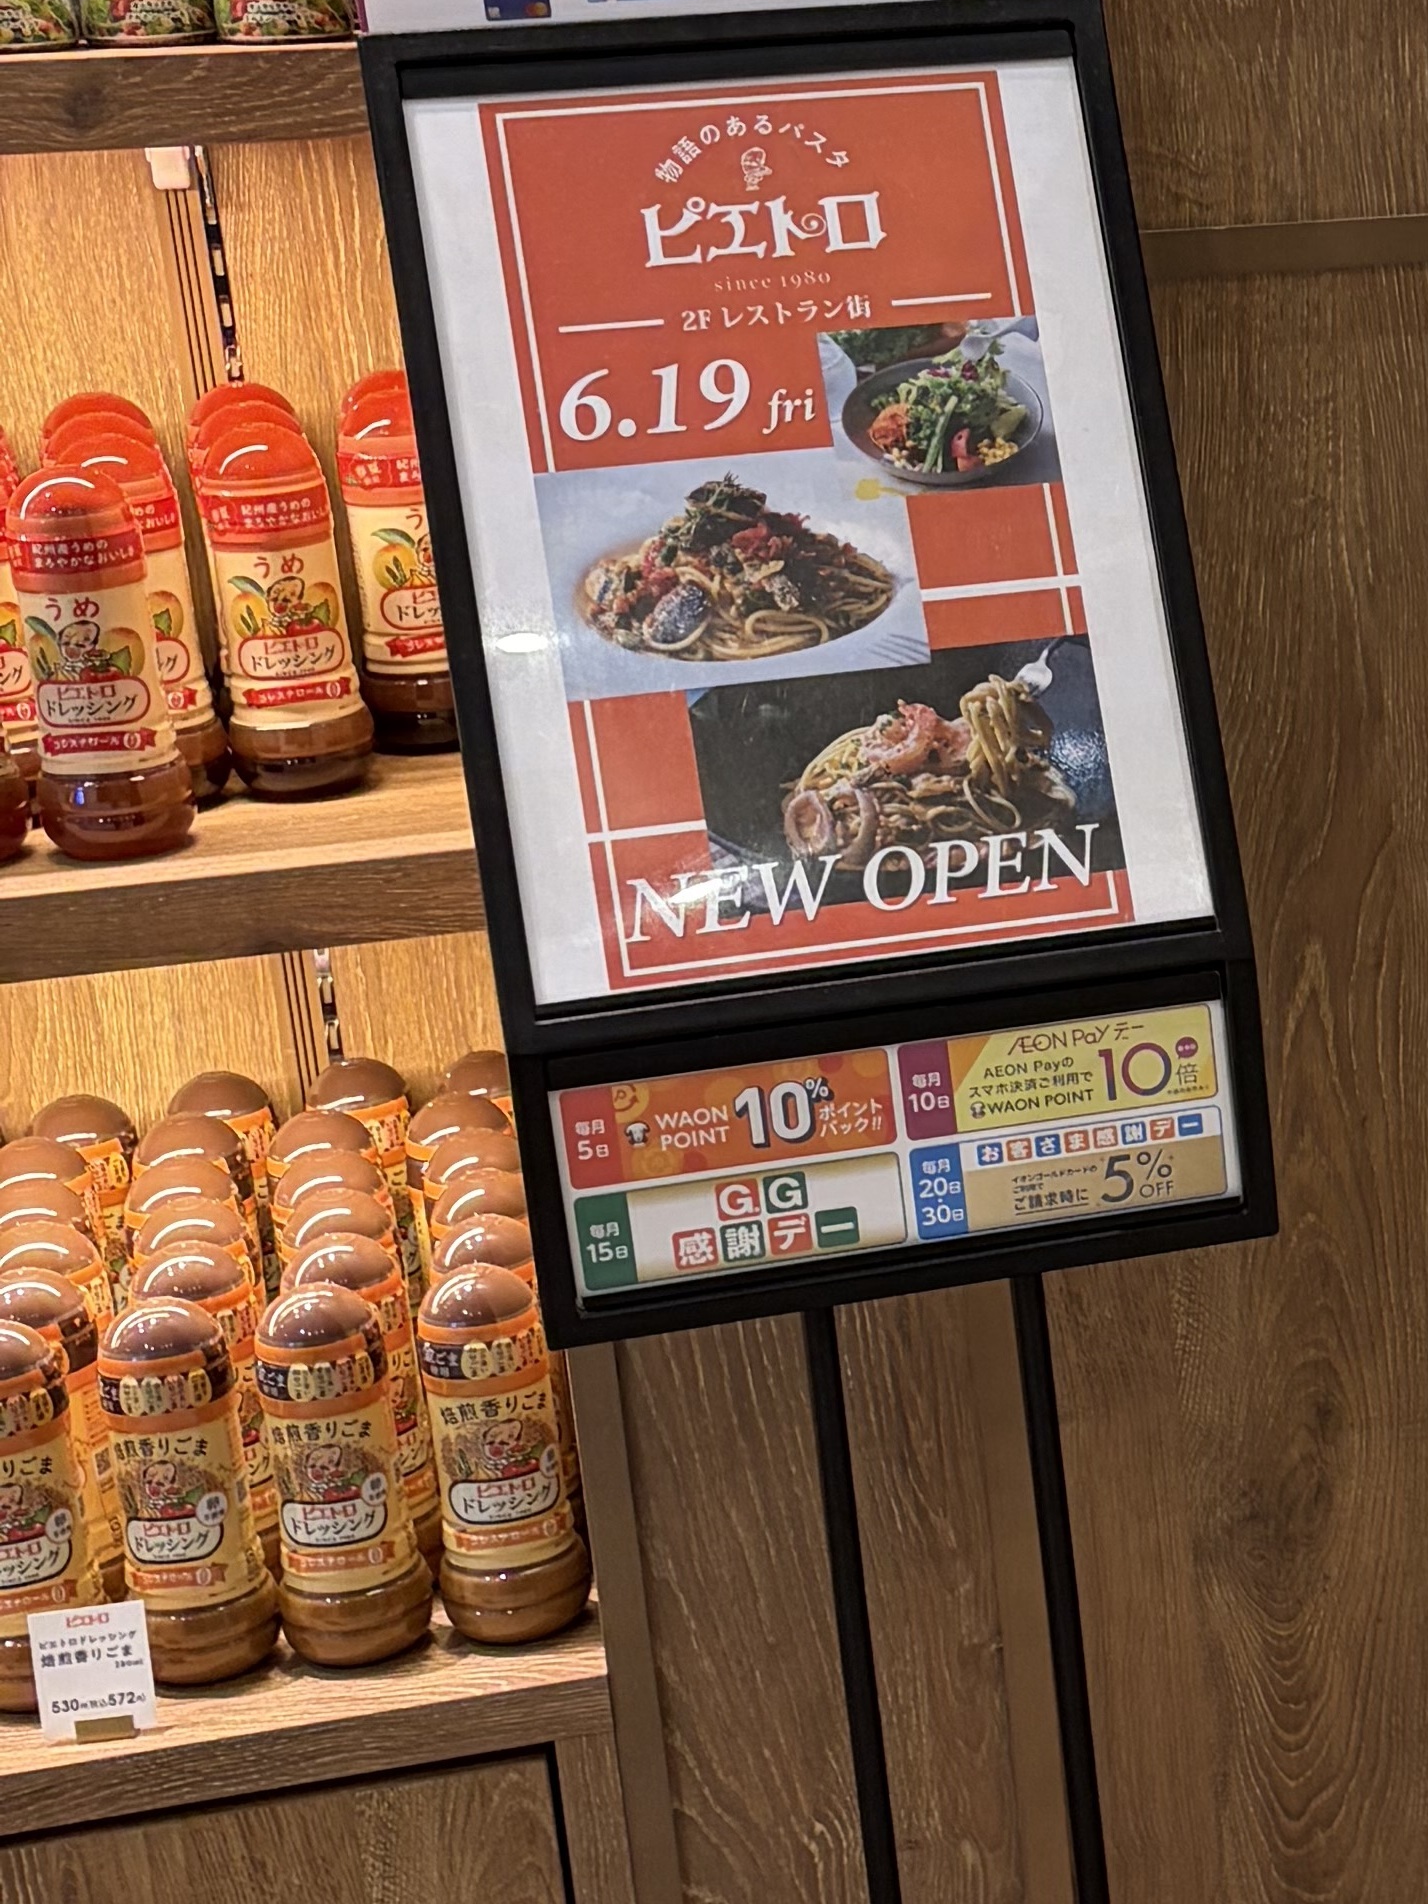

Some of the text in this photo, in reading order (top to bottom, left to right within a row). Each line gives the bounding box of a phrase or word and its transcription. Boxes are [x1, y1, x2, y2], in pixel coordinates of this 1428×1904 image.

[654, 114, 850, 183] 物語のあるパスタ
[640, 191, 887, 268] ピエトロ
[715, 270, 831, 292] since 1980
[559, 358, 816, 442] 6.19 fri
[254, 553, 304, 579] うめ
[45, 597, 100, 622] うめ
[251, 644, 335, 672] ドレッシング
[46, 695, 138, 717] ドレッシング
[627, 823, 1100, 943] NEW OPEN
[911, 1071, 941, 1088] 毎月
[984, 1062, 1028, 1079] AEON
[819, 1098, 883, 1121] ポイント
[908, 1091, 950, 1113] 10日
[988, 1089, 1094, 1115] WAON POINT
[575, 1119, 605, 1136] 毎月
[655, 1105, 729, 1130] WAON
[577, 1140, 609, 1160] 5日
[661, 1125, 730, 1152] POINT
[980, 1119, 1199, 1163] お客さま感謝デー
[921, 1158, 950, 1175] 毎月
[1139, 1181, 1174, 1198] OFF
[589, 1222, 620, 1239] 毎月
[677, 1217, 855, 1267] 感謝デー
[587, 1242, 628, 1263] 15日
